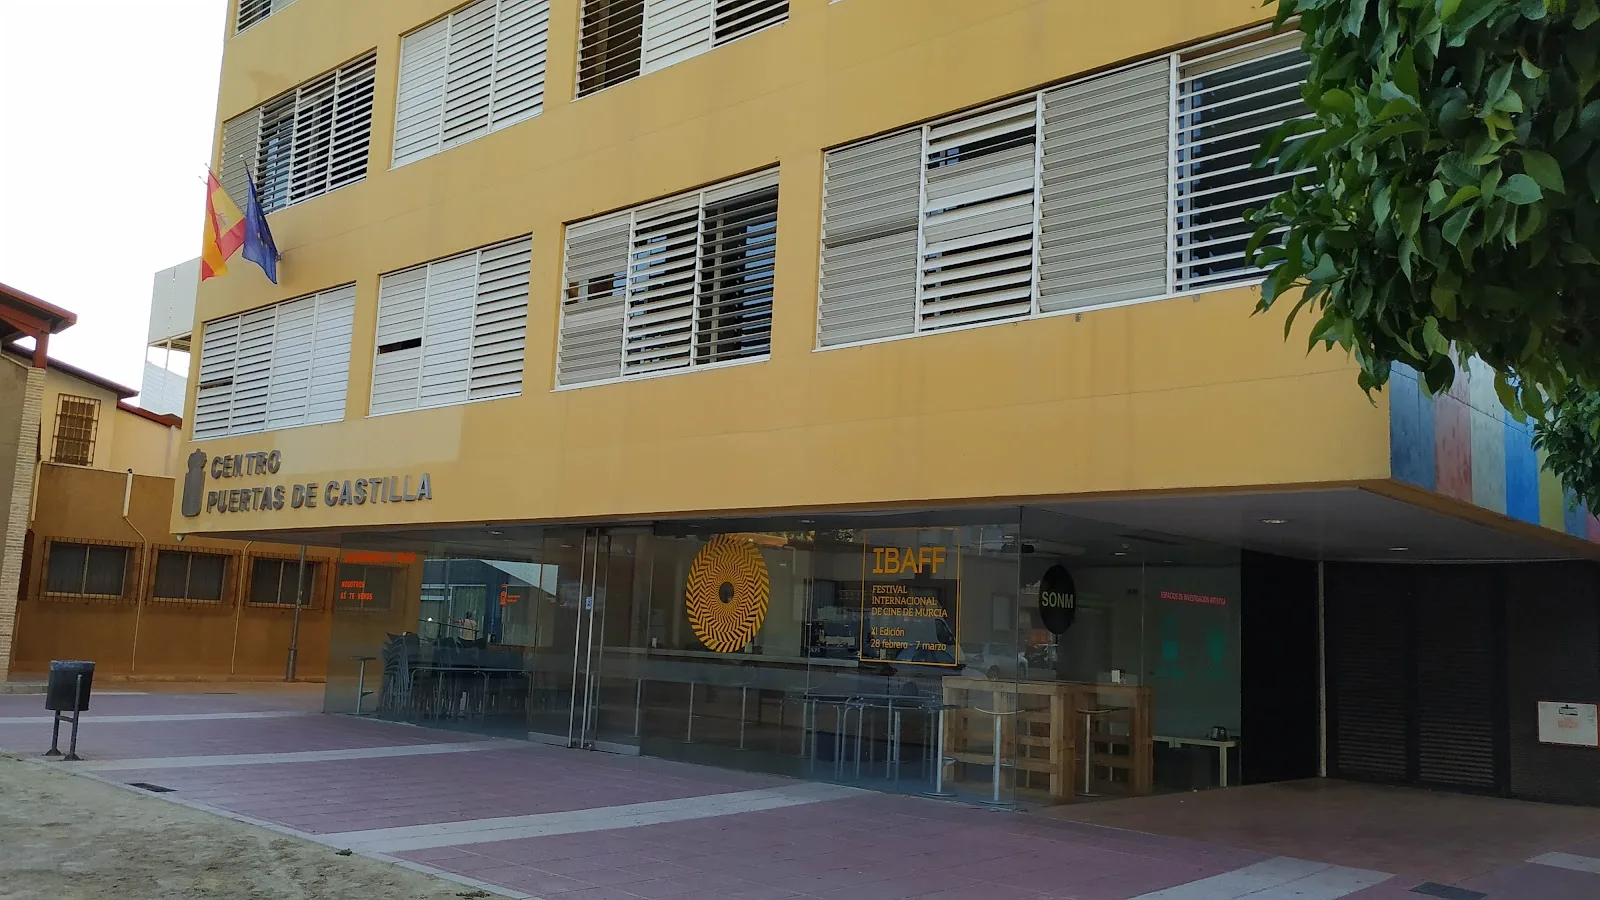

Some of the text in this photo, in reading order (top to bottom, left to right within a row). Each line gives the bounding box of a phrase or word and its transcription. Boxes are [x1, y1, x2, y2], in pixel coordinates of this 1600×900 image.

[211, 450, 282, 479] CENTRO
[206, 472, 433, 514] PUERTAS DE CASTILLA
[872, 547, 947, 574] IBAFF
[872, 585, 908, 594] FESTIVAL
[349, 592, 356, 600] TE
[872, 596, 937, 605] INTERNACIONAL
[1042, 591, 1074, 608] SONM
[872, 607, 948, 617] DE CINE DE MURCIA
[871, 627, 905, 636] XI Edición
[871, 639, 880, 648] 28
[882, 639, 908, 649] febrero
[915, 641, 920, 650] 7
[922, 643, 947, 651] marzo
